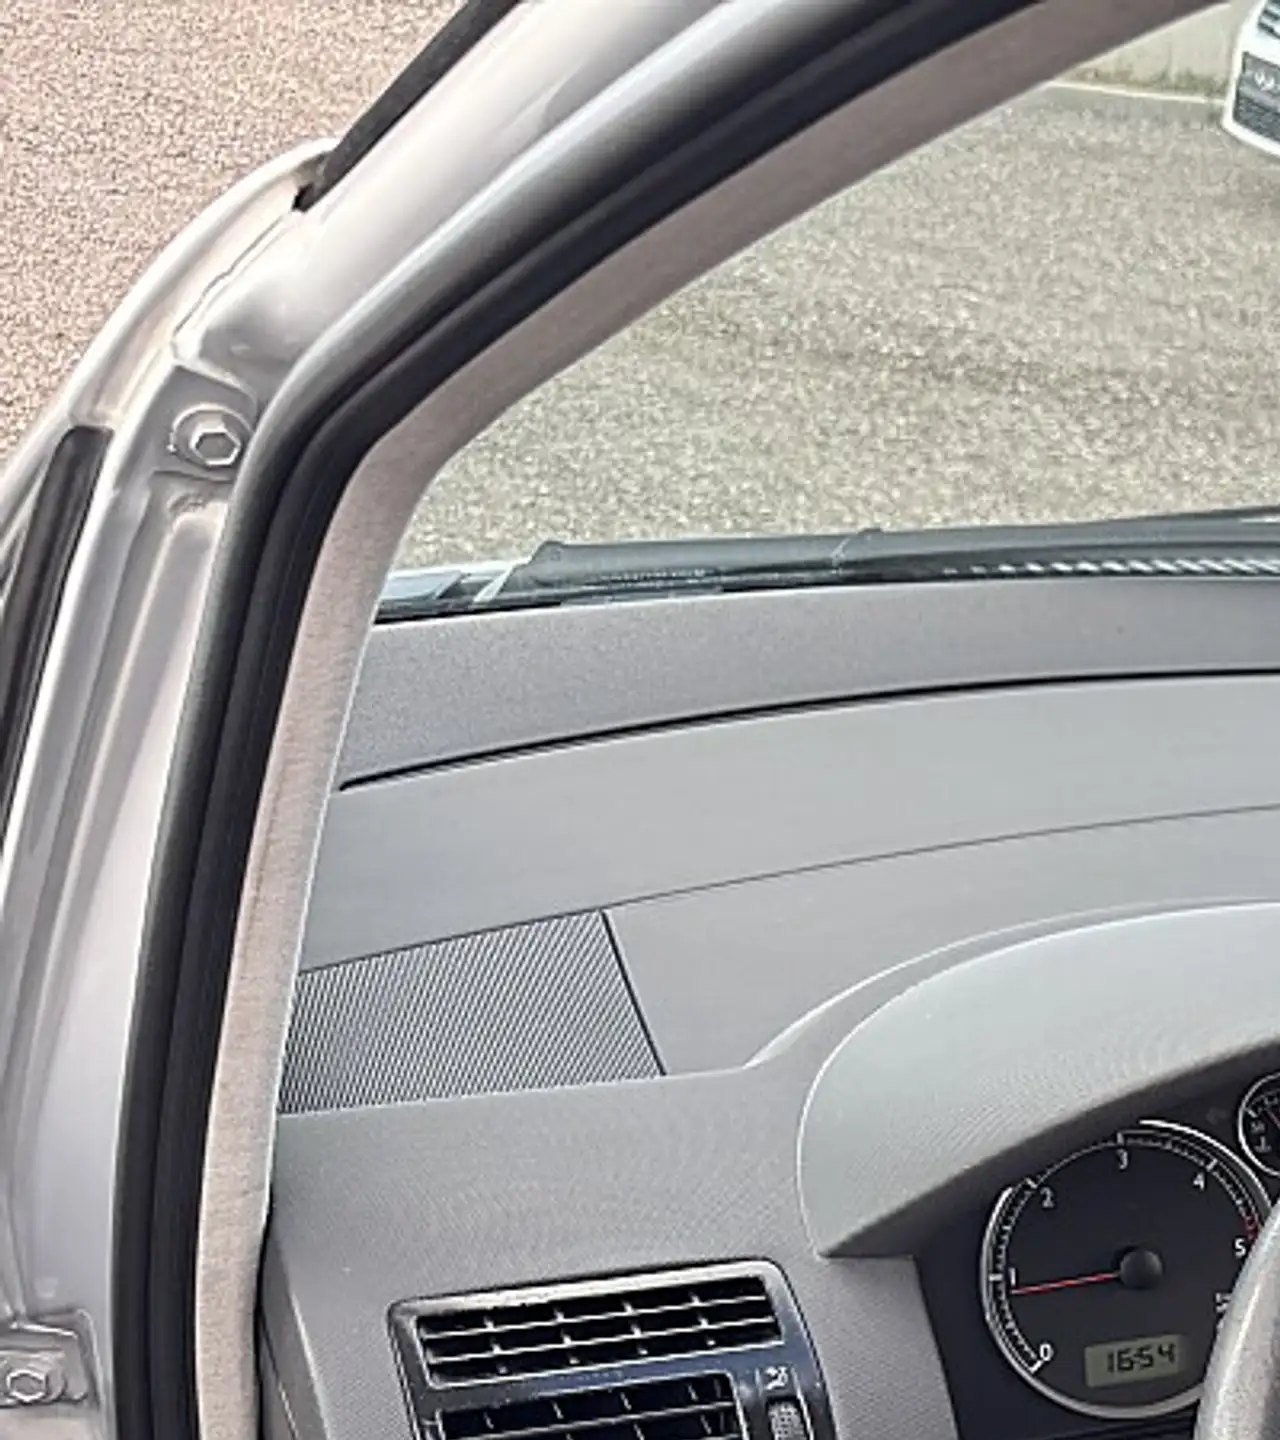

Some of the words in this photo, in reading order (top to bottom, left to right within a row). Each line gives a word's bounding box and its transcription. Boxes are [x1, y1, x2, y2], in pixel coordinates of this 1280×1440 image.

[1118, 1150, 1129, 1169] 3
[1193, 1173, 1206, 1191] 4
[1042, 1189, 1053, 1207] 2
[1235, 1240, 1246, 1256] 5
[1009, 1267, 1017, 1286] 1
[1039, 1344, 1053, 1361] 0
